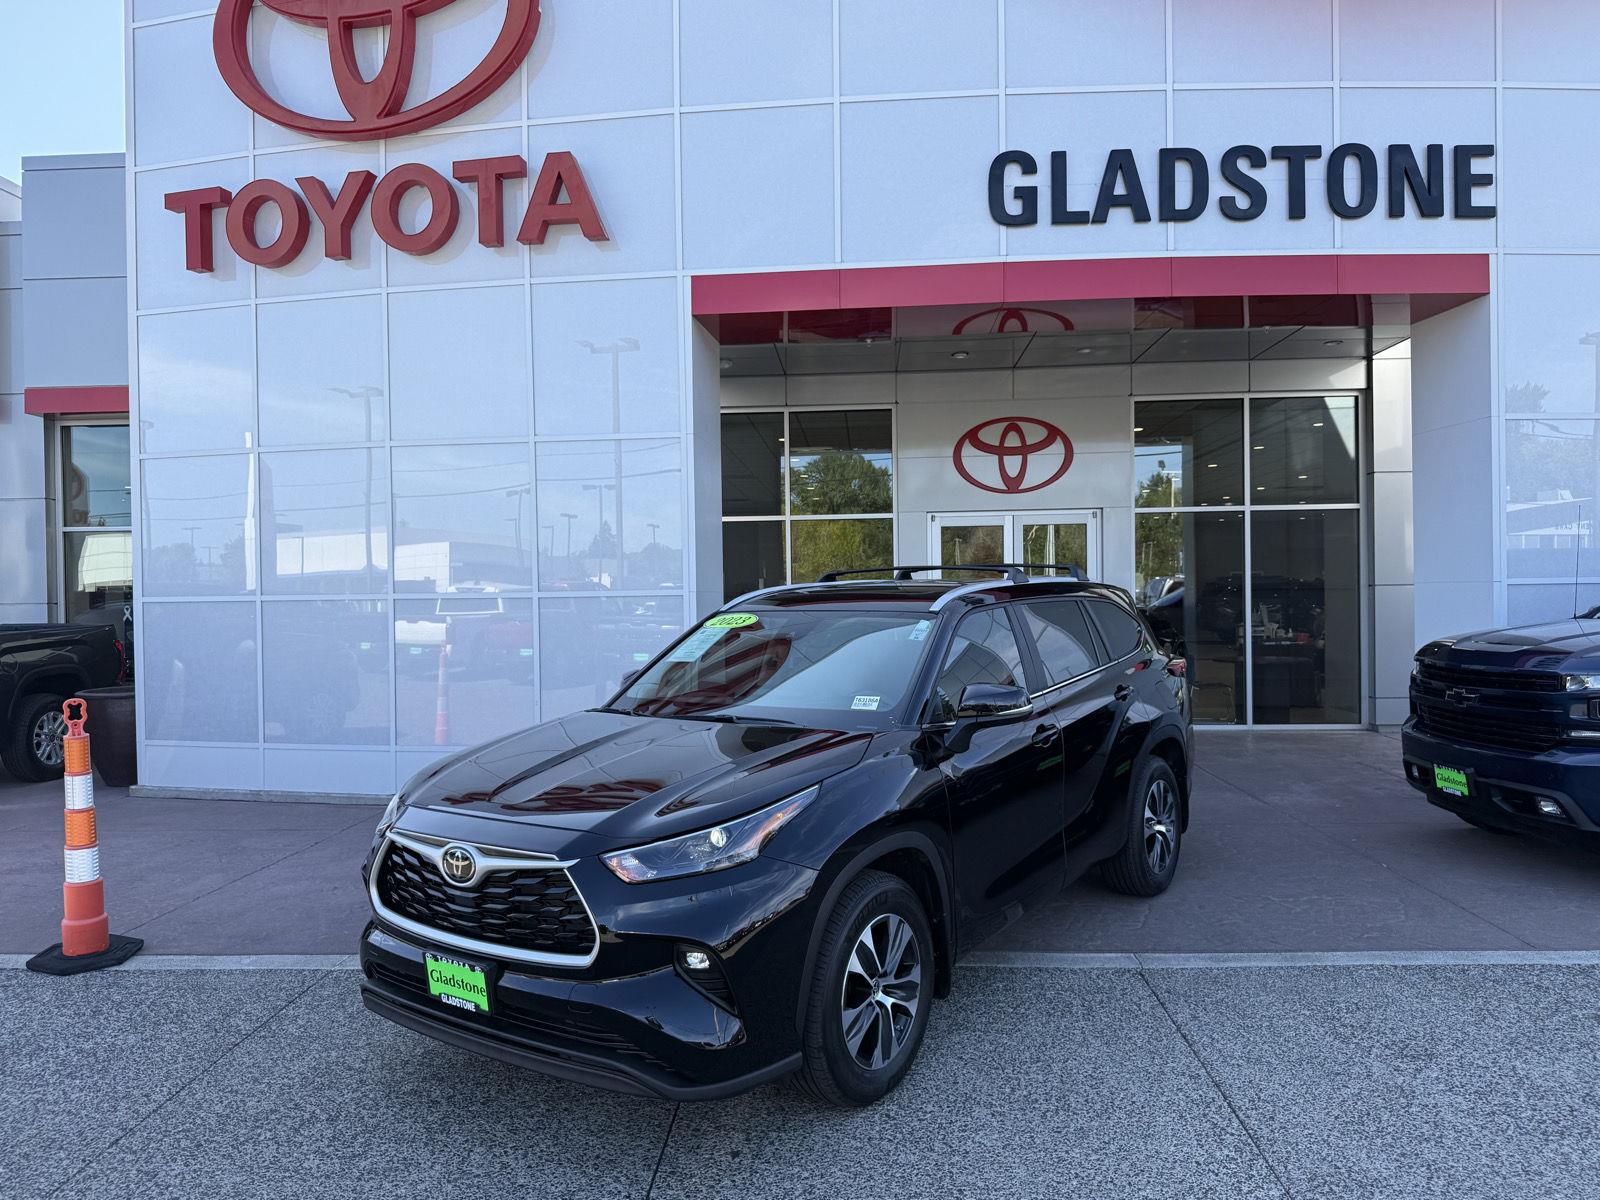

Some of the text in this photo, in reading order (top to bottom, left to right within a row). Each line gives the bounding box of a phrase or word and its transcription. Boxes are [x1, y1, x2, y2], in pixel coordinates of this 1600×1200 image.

[988, 143, 1497, 226] GLADSTONE
[164, 151, 610, 274] TOYOTA
[710, 616, 752, 626] 2023
[1436, 773, 1468, 788] Gladstone
[436, 955, 470, 969] TOYOTA
[430, 969, 487, 997] Gladstone
[441, 994, 476, 1012] GLADSTONE
